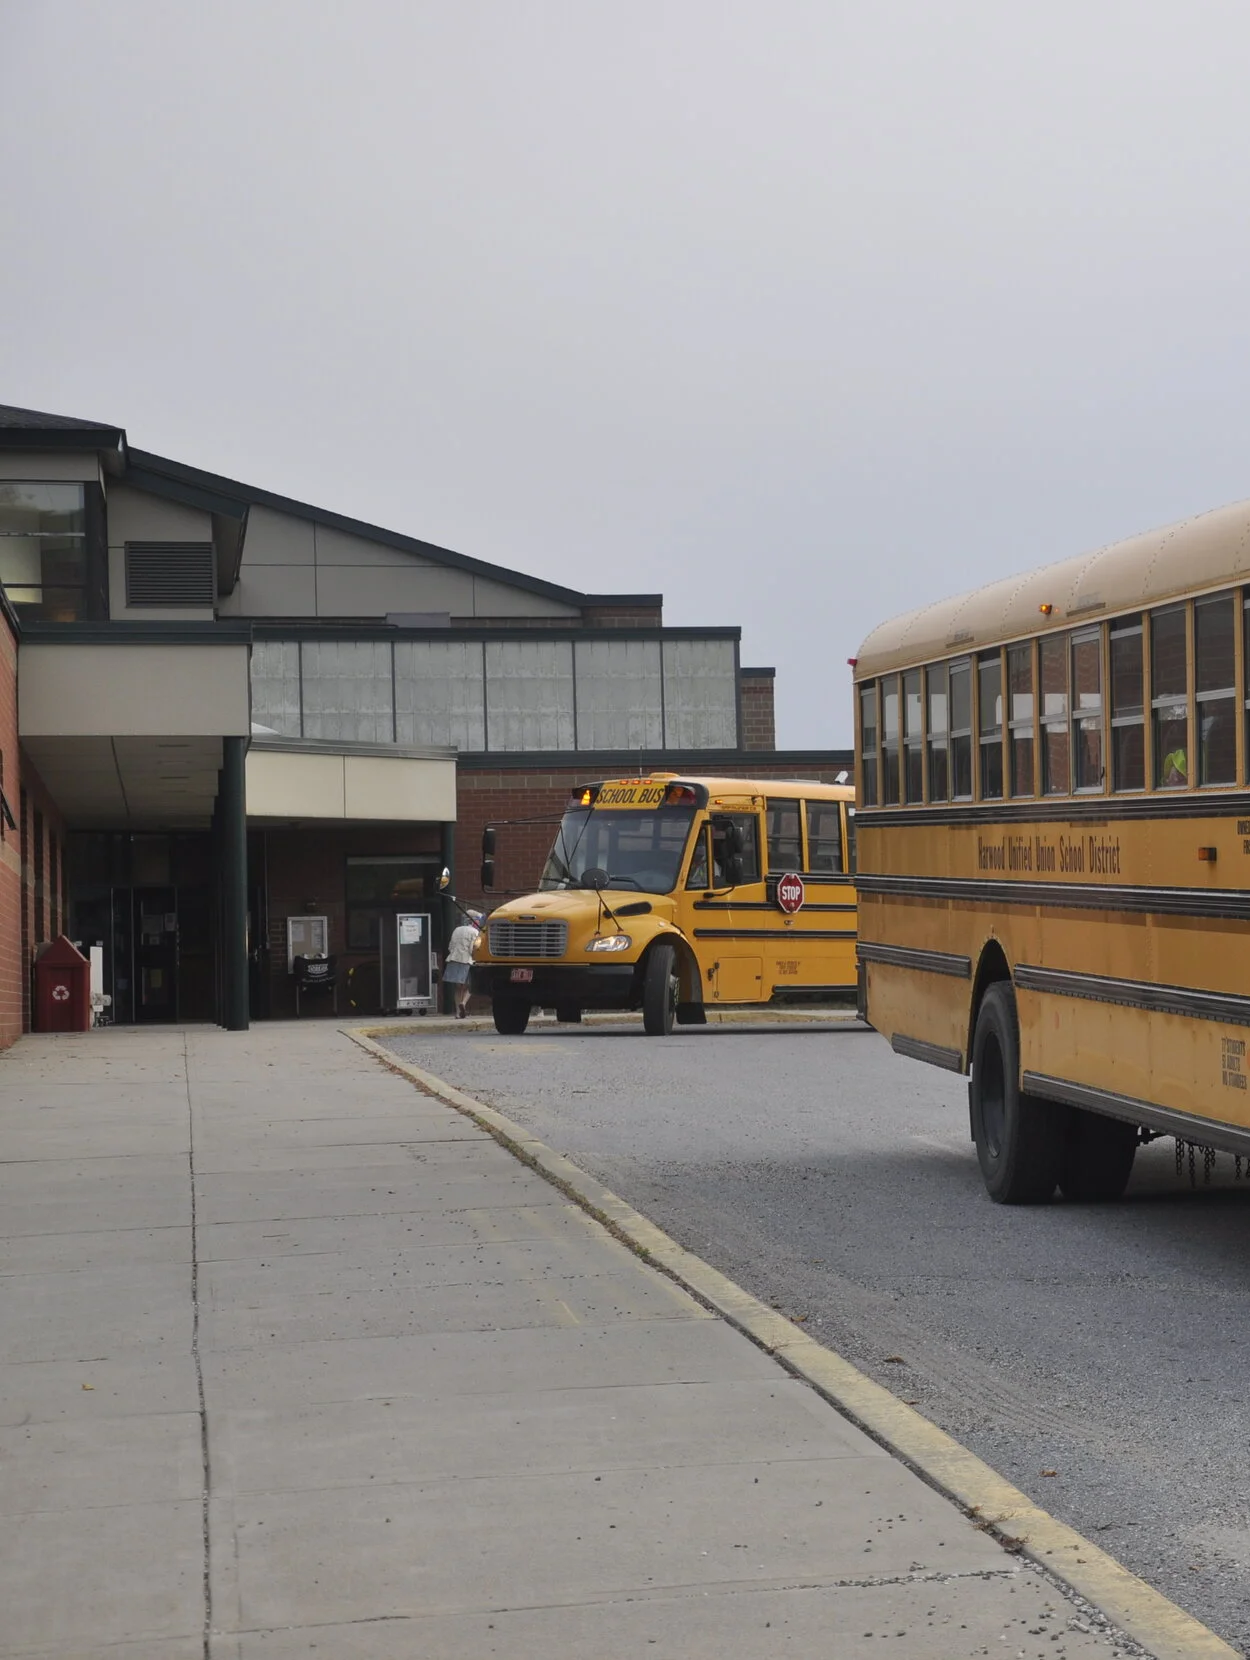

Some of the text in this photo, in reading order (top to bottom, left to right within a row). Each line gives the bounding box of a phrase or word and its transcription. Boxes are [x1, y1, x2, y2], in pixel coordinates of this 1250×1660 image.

[597, 788, 664, 804] SCHOOL BUS
[978, 835, 1120, 874] Harwood Unified Union School District
[782, 885, 801, 901] STOP
